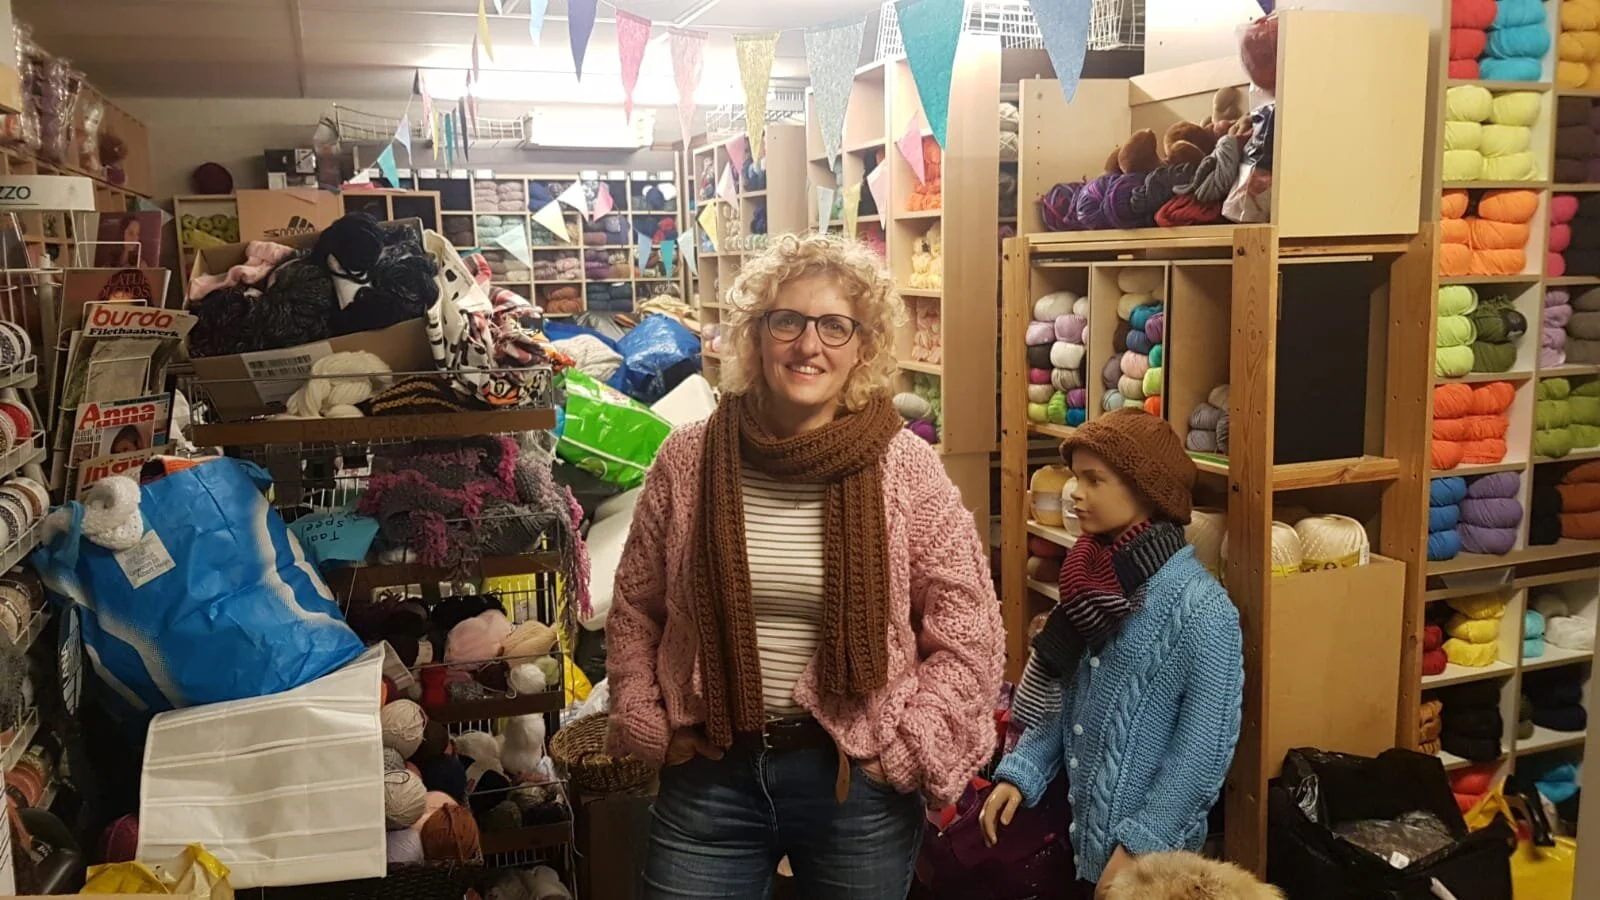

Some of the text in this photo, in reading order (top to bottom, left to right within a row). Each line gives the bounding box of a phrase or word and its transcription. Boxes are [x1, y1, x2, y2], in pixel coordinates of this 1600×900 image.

[93, 305, 173, 328] burda
[89, 327, 179, 337] Filethaakwerk
[78, 403, 155, 432] Anna
